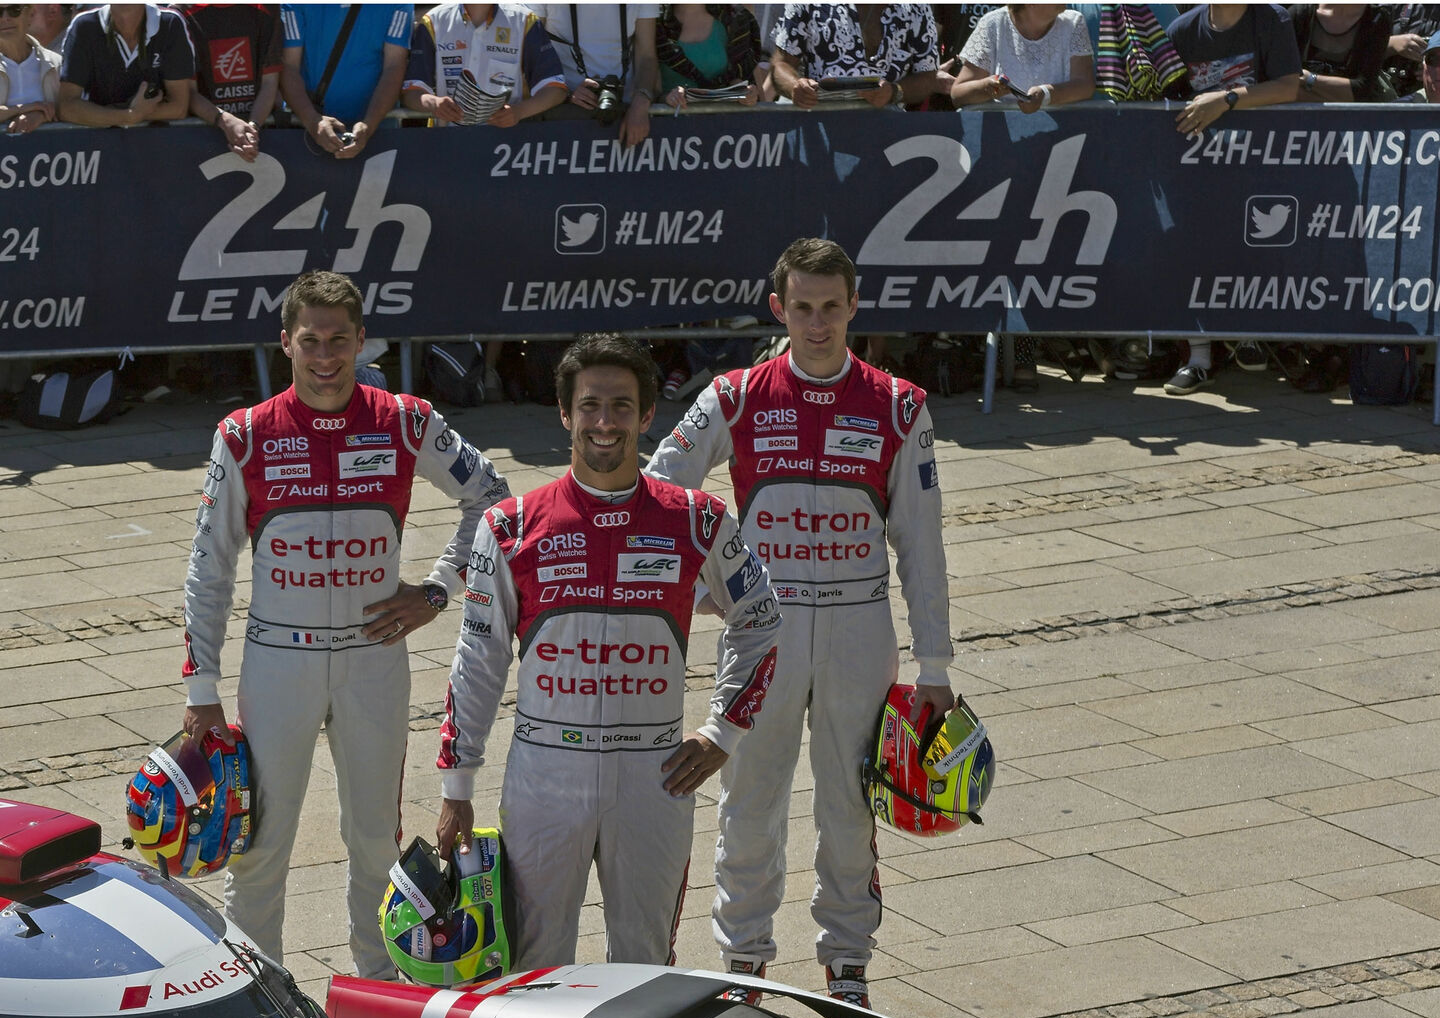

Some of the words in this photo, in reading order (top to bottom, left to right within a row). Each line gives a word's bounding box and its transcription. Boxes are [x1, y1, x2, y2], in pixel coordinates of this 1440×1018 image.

[486, 45, 519, 55] RENAULT
[215, 84, 255, 99] CAISSE
[491, 133, 785, 177] 24H-LEMANS.COM
[855, 133, 1118, 266] 24h
[177, 149, 432, 281] 24h
[1307, 204, 1423, 240] #LM24
[615, 210, 724, 245] #LM24
[502, 279, 765, 312] LEMANS-TV.COM
[926, 276, 1098, 309] MANS
[1187, 276, 1440, 312] LEMANS-TV.CO
[167, 288, 239, 322] LE
[754, 408, 797, 426] ORIS
[262, 436, 309, 454] ORIS
[768, 438, 796, 448] BOSCH
[840, 436, 881, 450] WEC
[264, 453, 282, 461] Swiss
[283, 451, 310, 460] Watches
[353, 454, 394, 466] WEC
[280, 466, 308, 477] BOSCH
[775, 457, 814, 471] Audi
[819, 460, 866, 475] Sport
[289, 484, 328, 498] Audi
[337, 481, 383, 498] Sport
[756, 507, 870, 533] e-tron
[271, 536, 388, 560] e-tron
[537, 532, 587, 555] ORIS
[758, 541, 871, 564] quattro
[538, 552, 557, 562] Swiss
[557, 548, 587, 558] Watches
[633, 559, 678, 570] WEC
[271, 566, 385, 590] quattro
[554, 566, 585, 577] BOSCH
[562, 584, 605, 598] Audi
[612, 587, 664, 603] Sport
[817, 588, 843, 599] Jarvis
[332, 633, 356, 643] Duval
[536, 638, 669, 665] e-tron
[536, 673, 668, 698] quattro
[613, 733, 642, 743] Grassi
[943, 745, 969, 768] Technik
[174, 777, 192, 796] Audi
[485, 878, 493, 896] 007
[410, 890, 426, 909] Audi
[164, 969, 224, 1000] Audi
